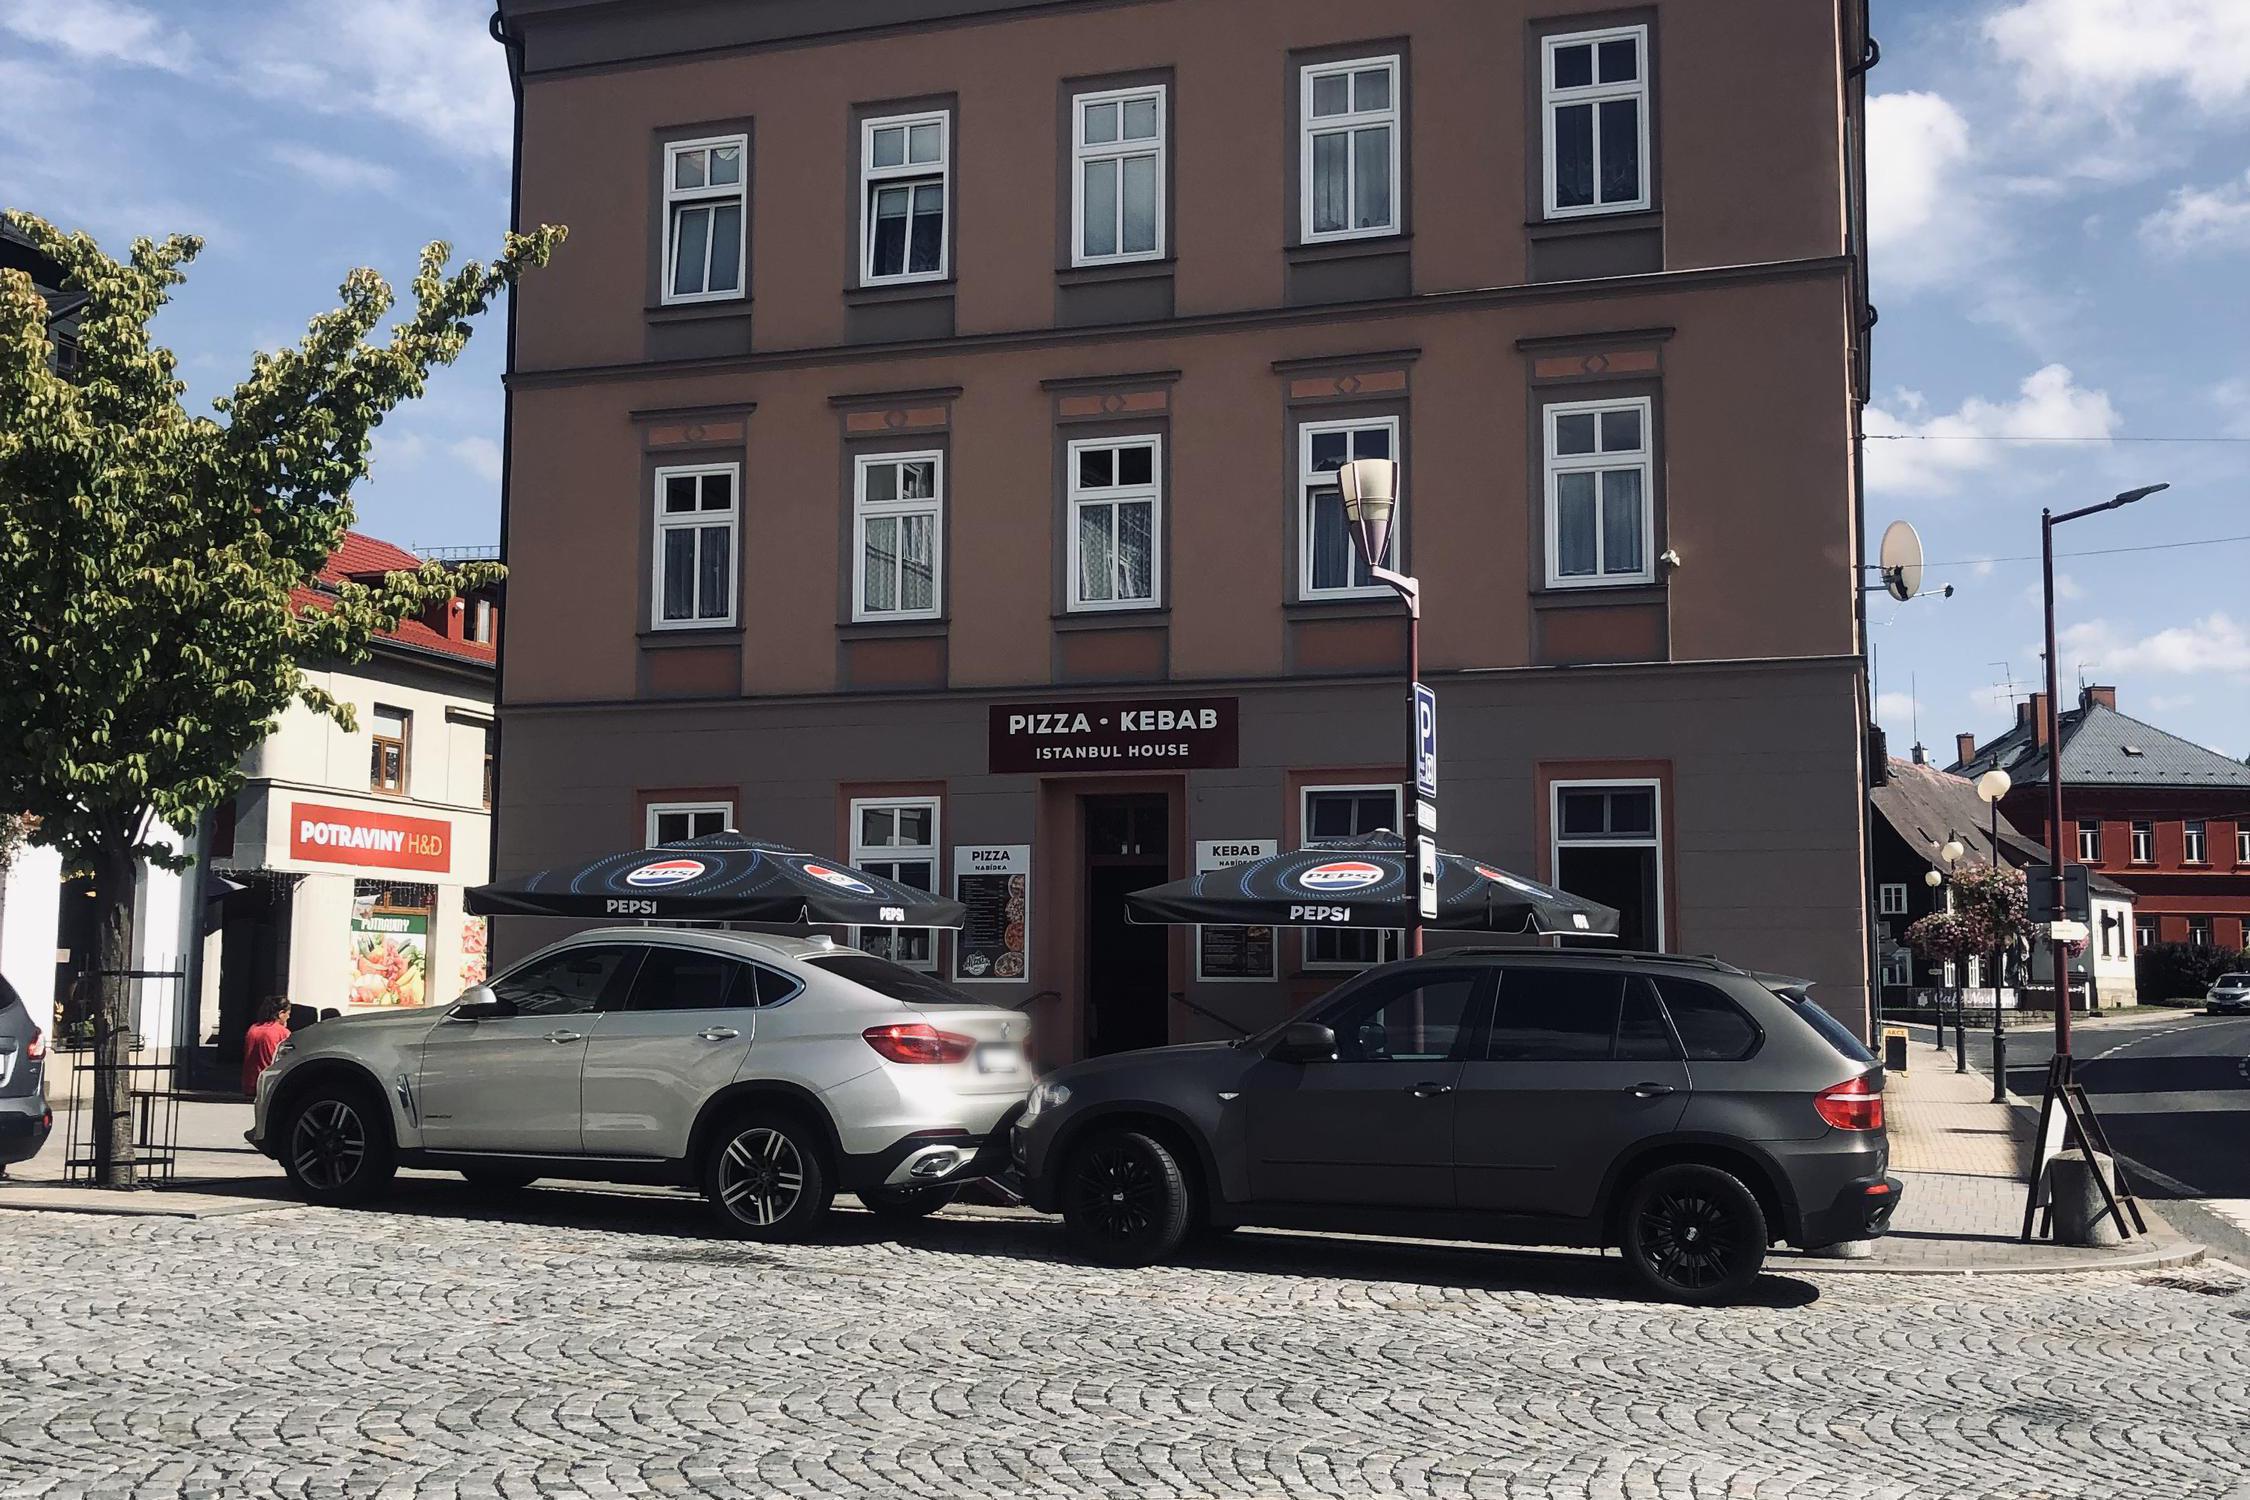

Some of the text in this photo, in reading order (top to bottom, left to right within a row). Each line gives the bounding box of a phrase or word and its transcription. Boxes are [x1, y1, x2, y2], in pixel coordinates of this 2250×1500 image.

[1009, 709, 1218, 735] PIZZA KEBAB
[1420, 701, 1431, 757] P
[1036, 744, 1189, 759] ISTANBUL HOUSE
[300, 820, 443, 856] POTRAVINY H&D
[972, 851, 1010, 861] PIZZA
[1212, 845, 1260, 856] KEBAB
[606, 900, 657, 914] PEPSI
[880, 907, 904, 921] PEPSI
[1290, 905, 1350, 921] PEPSI
